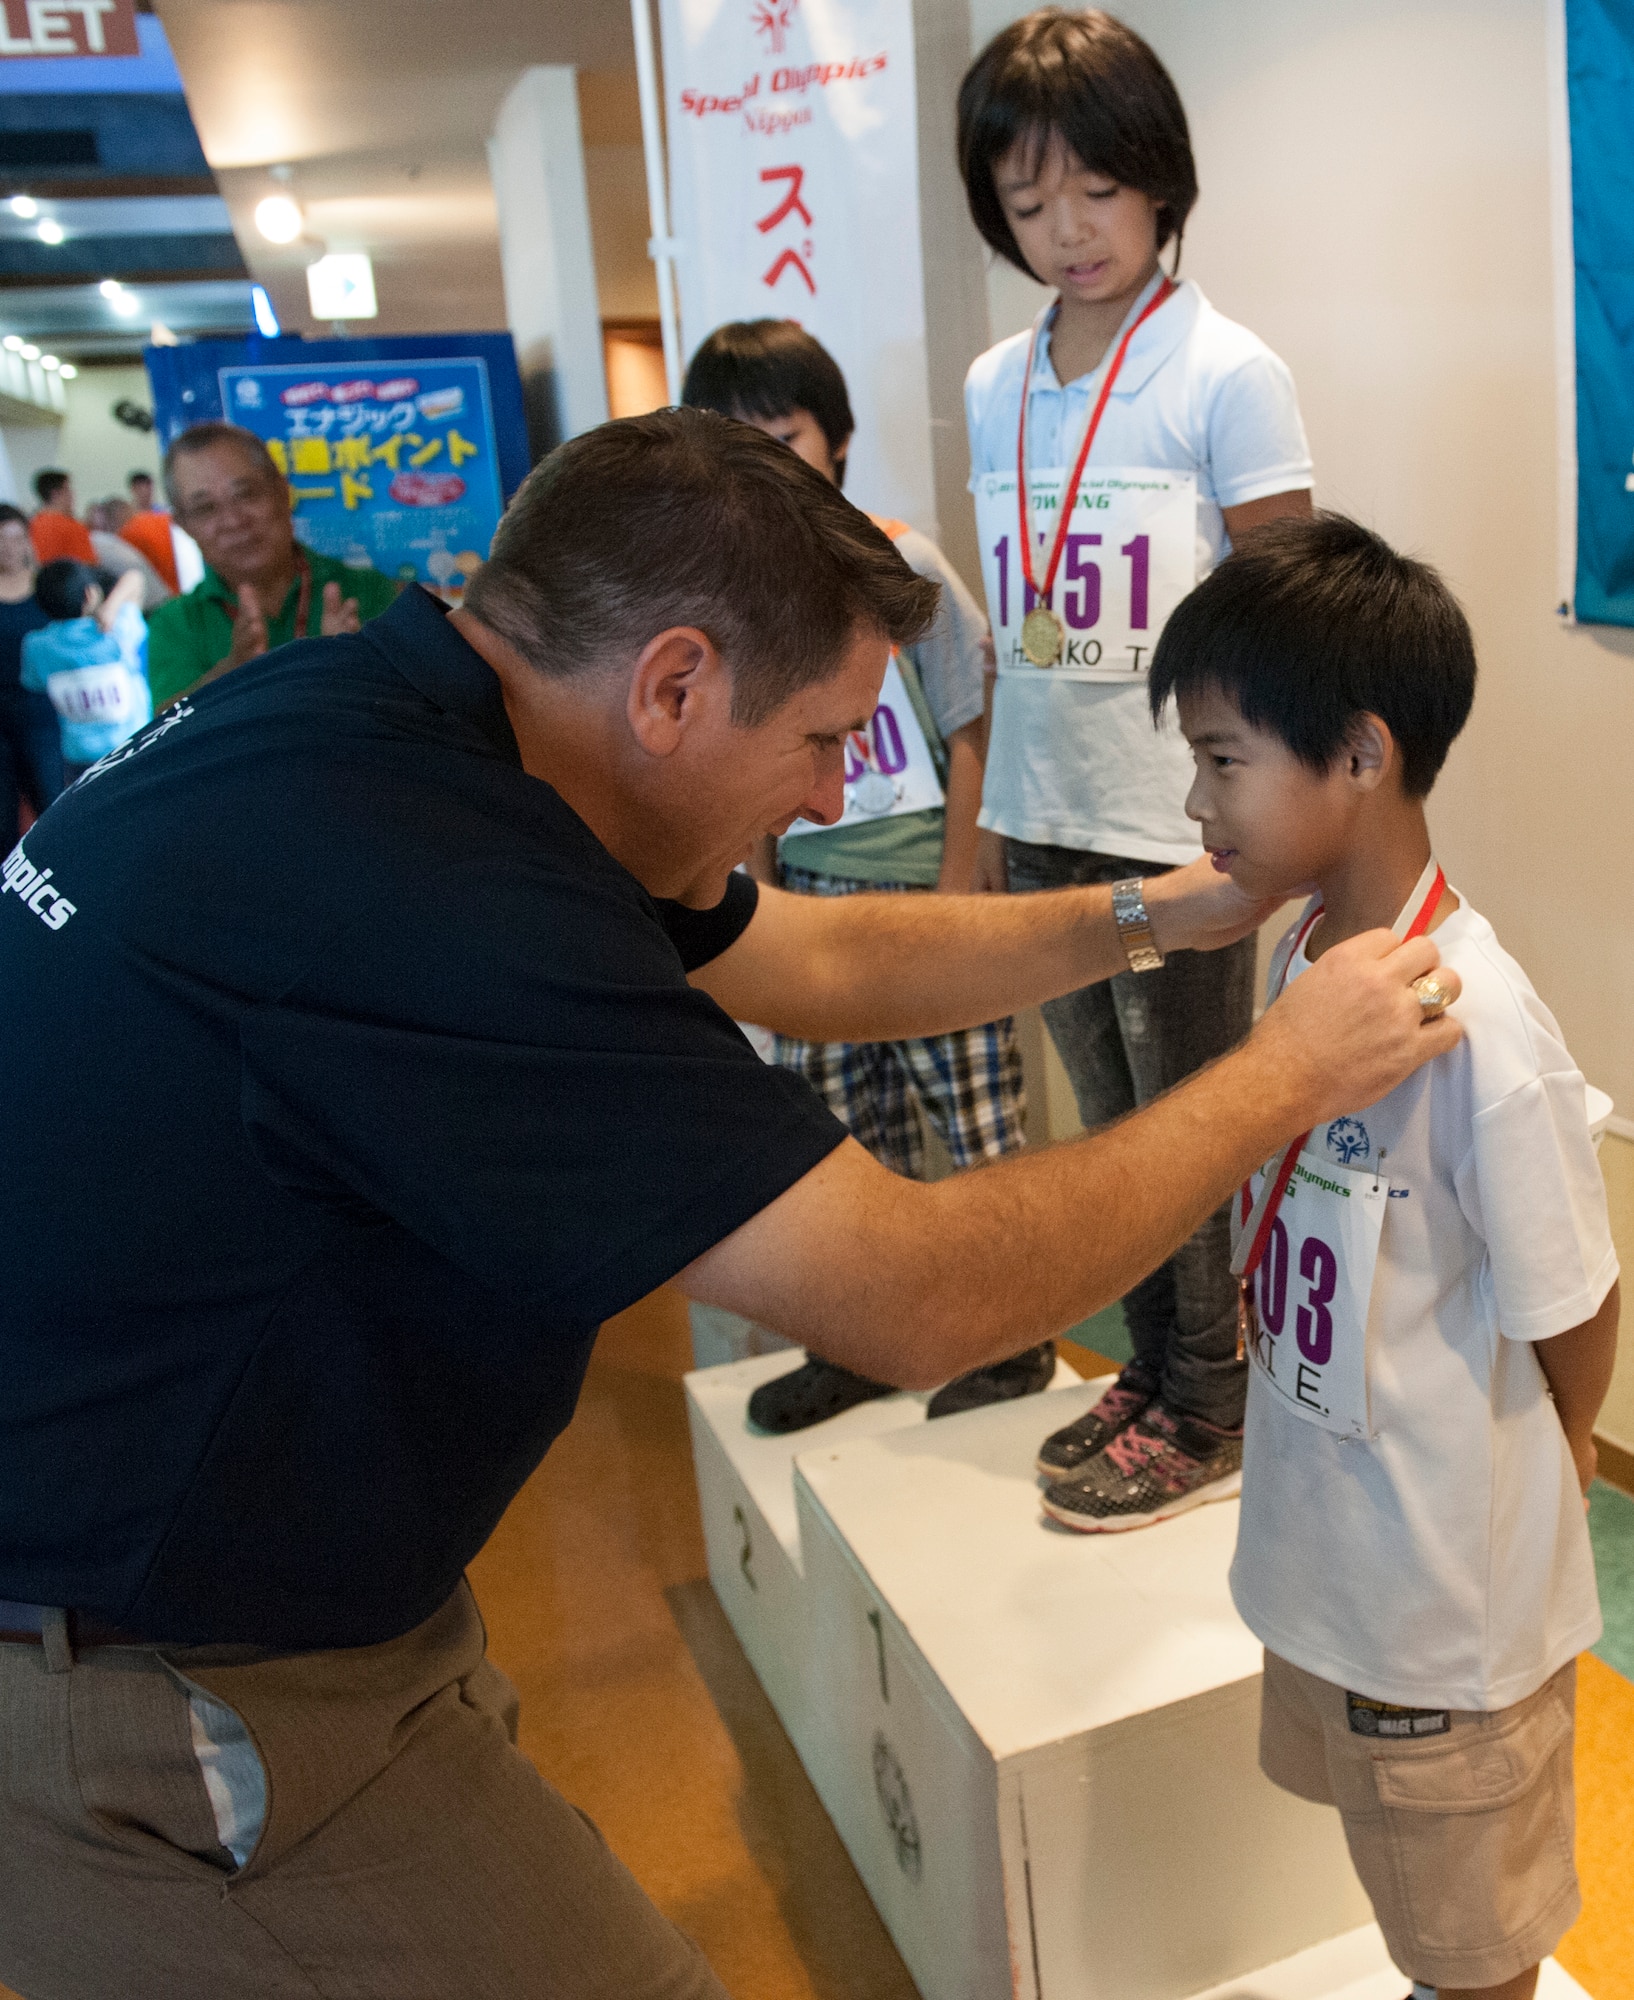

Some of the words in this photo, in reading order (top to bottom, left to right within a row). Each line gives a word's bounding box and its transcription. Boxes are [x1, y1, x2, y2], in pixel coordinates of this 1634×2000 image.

[290, 473, 374, 511] ード
[1252, 1215, 1337, 1366] 03
[1296, 1362, 1330, 1415] E.
